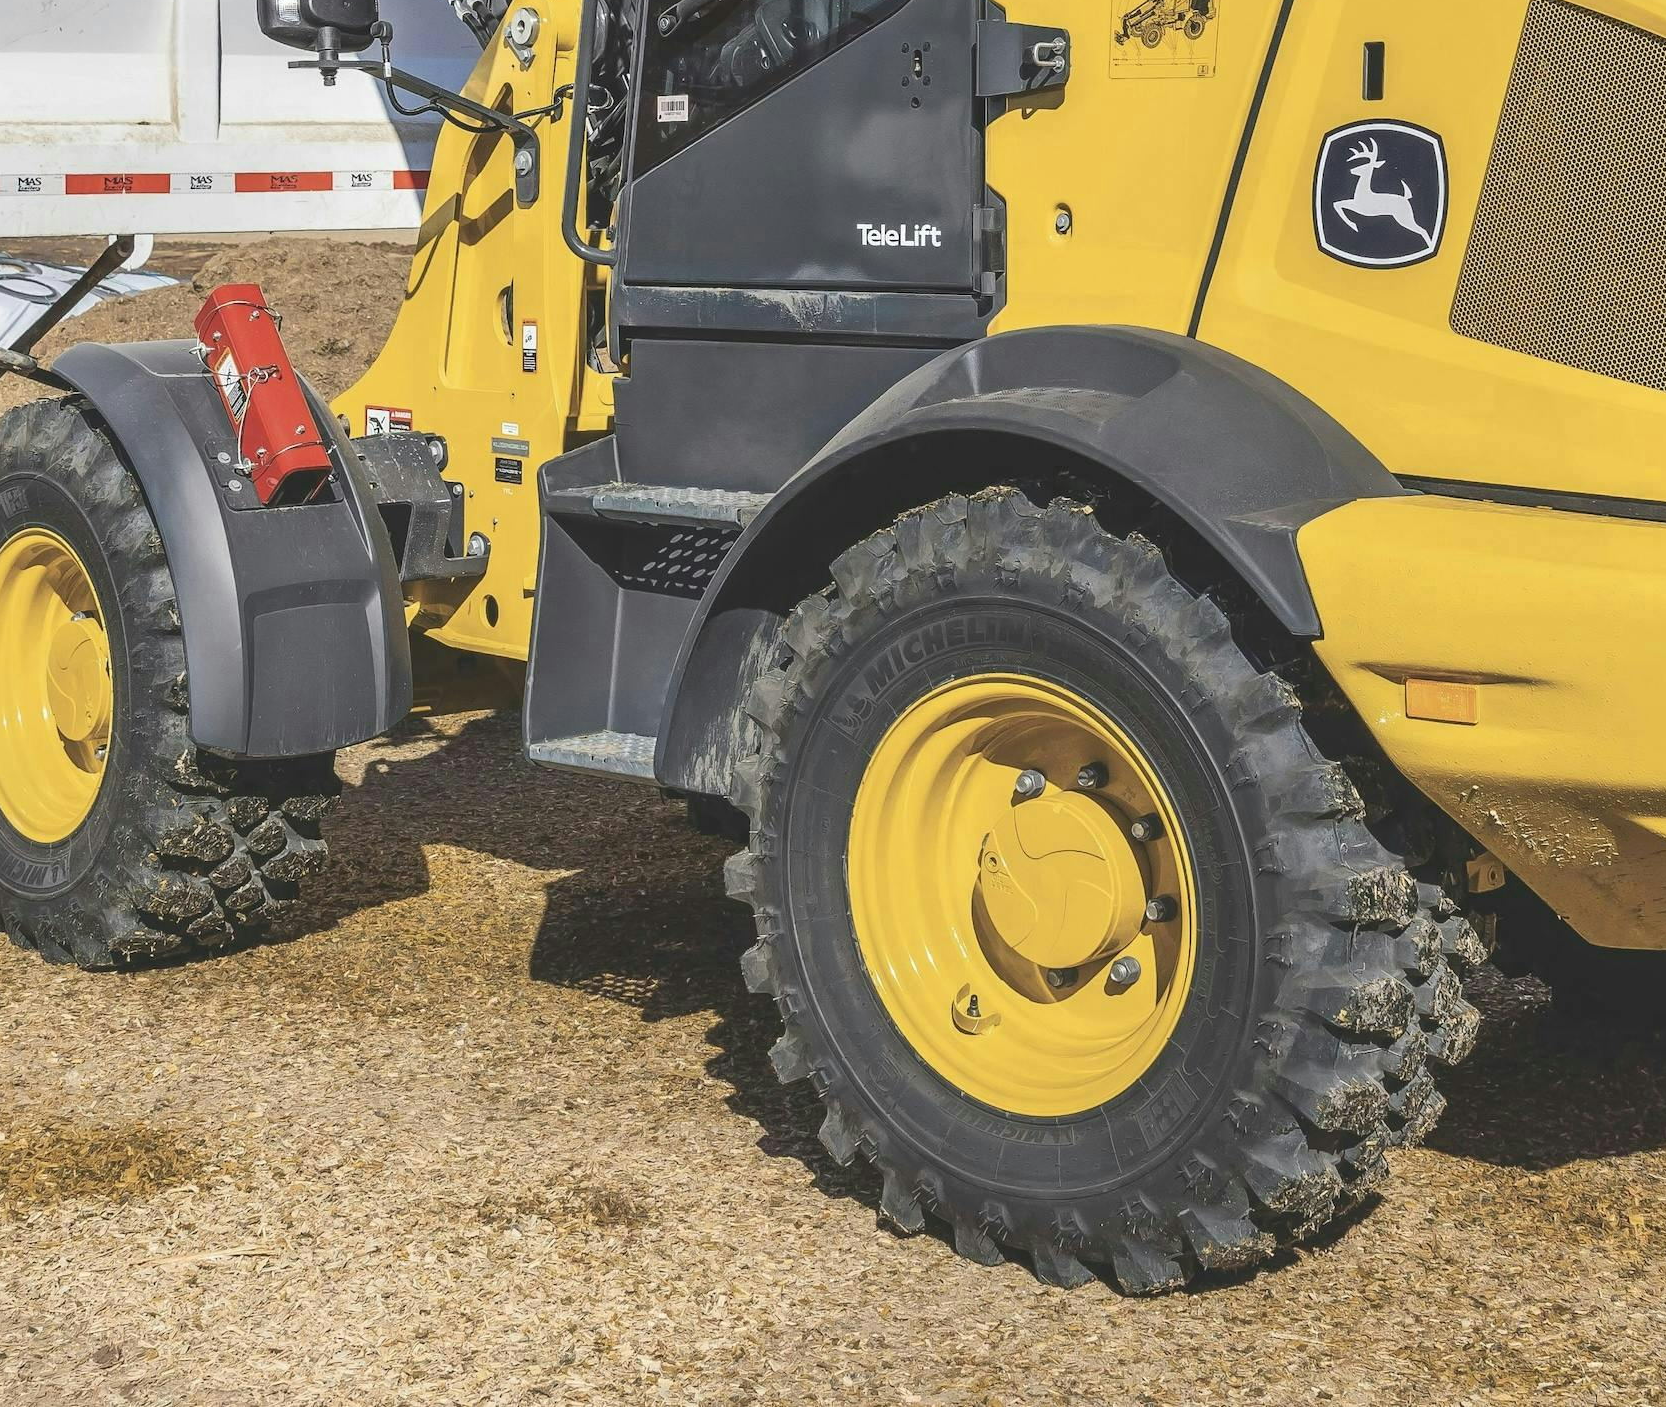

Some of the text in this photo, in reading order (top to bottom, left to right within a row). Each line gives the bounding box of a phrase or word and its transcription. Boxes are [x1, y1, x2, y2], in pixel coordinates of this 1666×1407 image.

[17, 177, 42, 185] MAS
[104, 177, 133, 185] MAS
[190, 176, 212, 184] MAS
[270, 175, 298, 183] MAS
[351, 173, 372, 182] MAS
[856, 223, 942, 248] TeleLift
[862, 614, 1030, 697] MICHELIN
